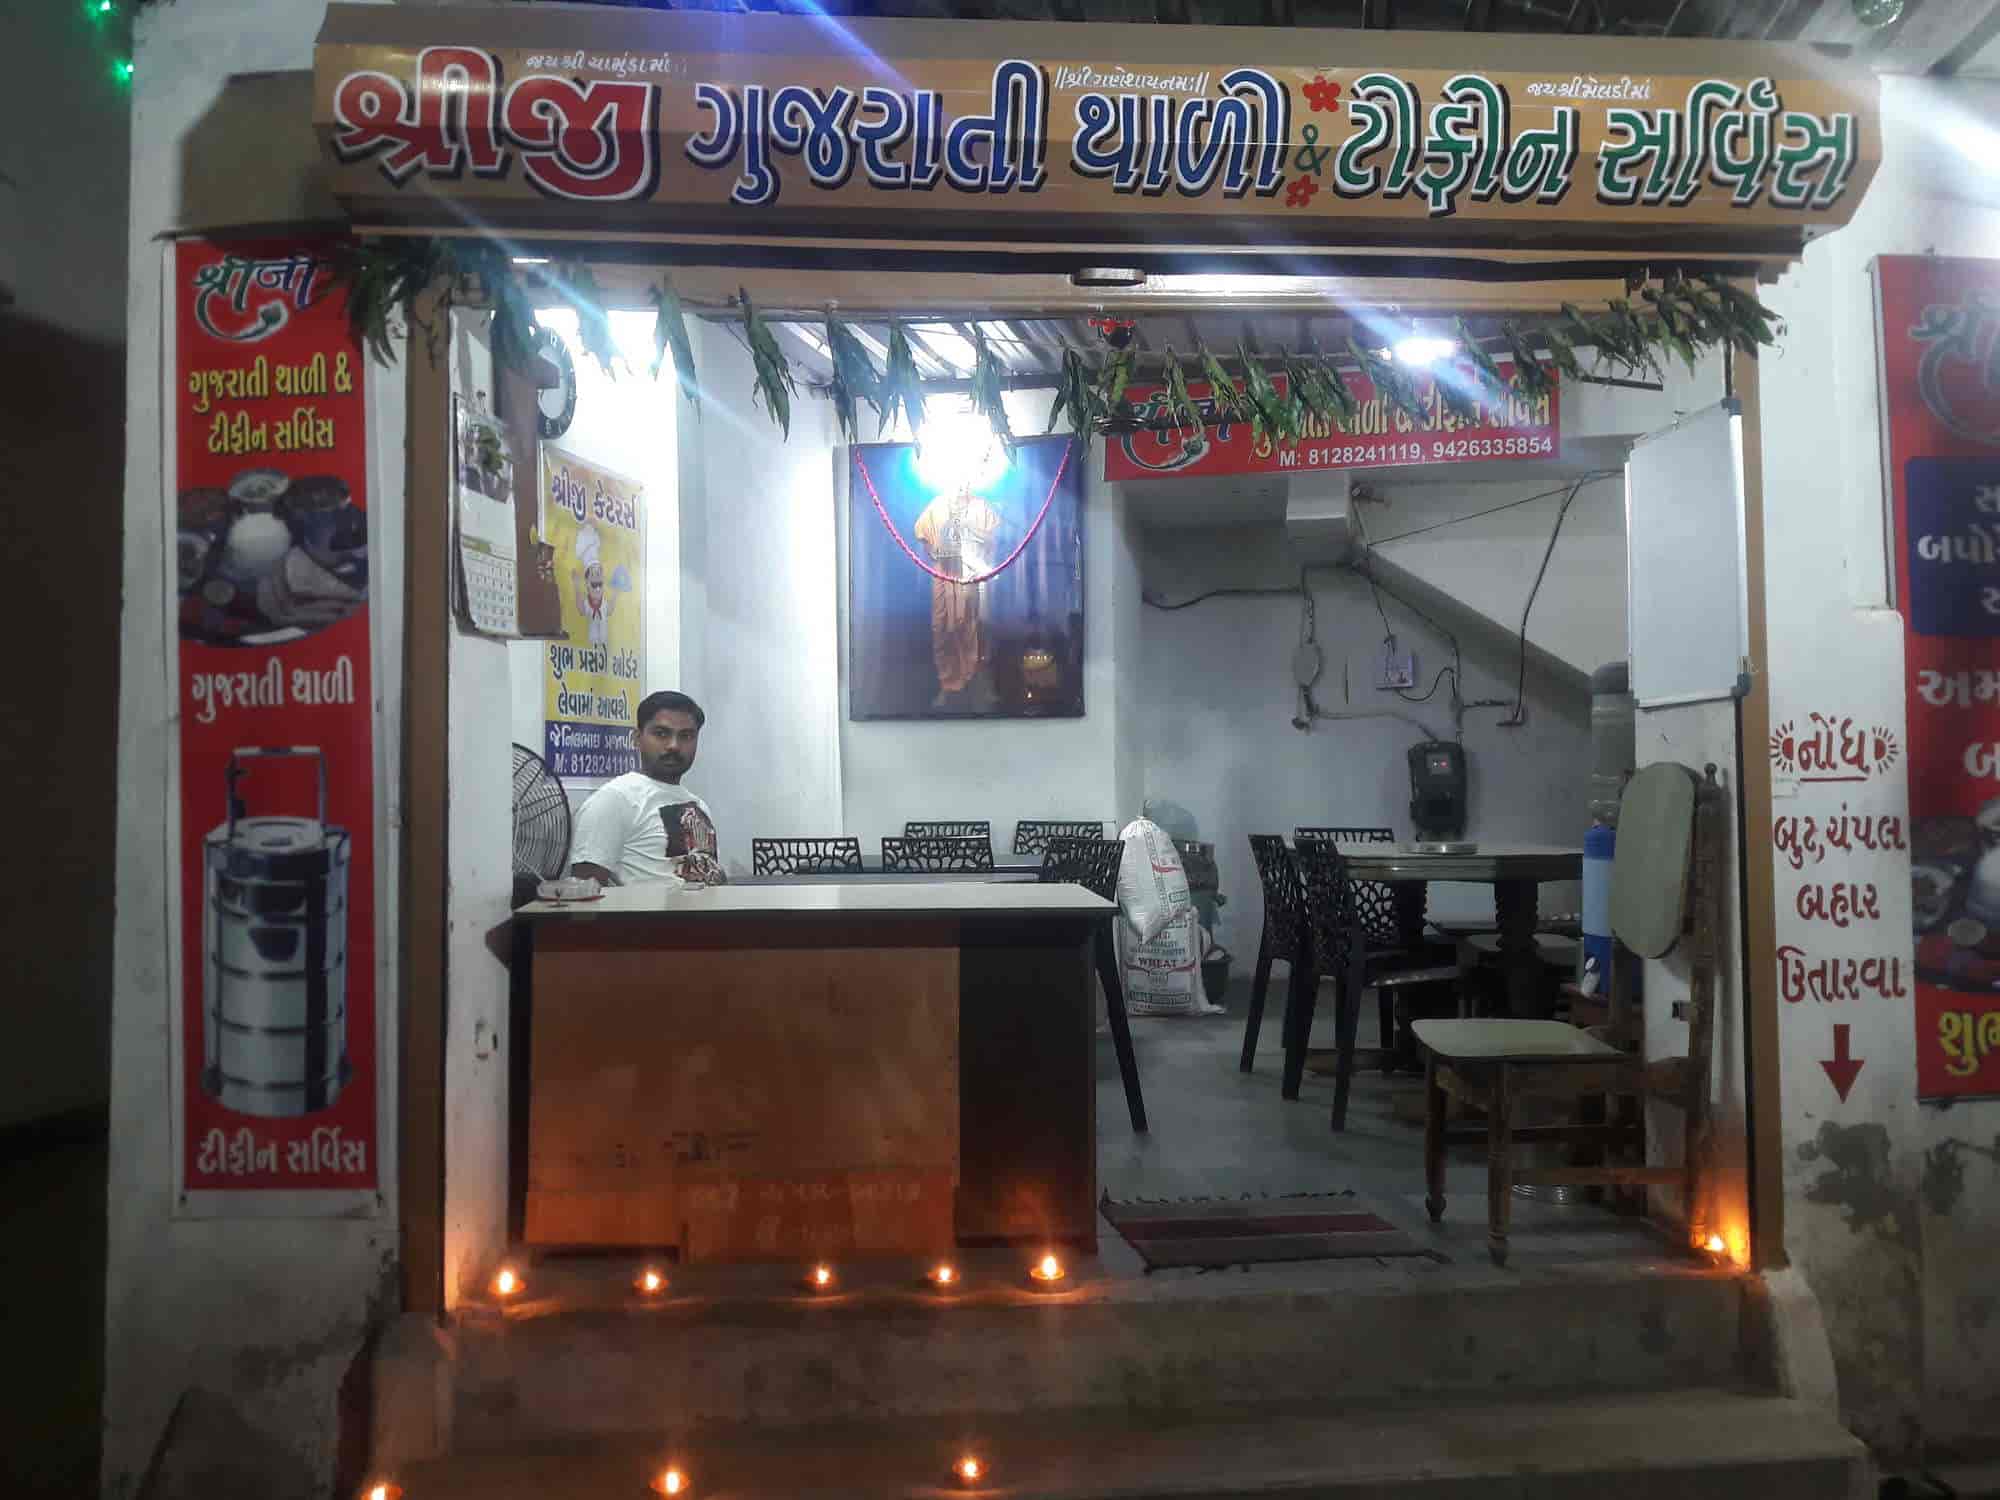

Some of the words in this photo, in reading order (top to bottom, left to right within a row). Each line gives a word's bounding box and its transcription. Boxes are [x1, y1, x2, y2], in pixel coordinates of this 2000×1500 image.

[332, 46, 658, 202] શ્રીજી
[684, 60, 1046, 205] ગુજરાતી
[1070, 68, 1288, 198] થાળી
[1294, 123, 1330, 177] &
[1334, 72, 1578, 217] ટીફીન
[189, 355, 268, 413] ગુજરાતી
[275, 352, 327, 394] થાળી
[334, 351, 352, 392] &
[208, 411, 267, 454] ટીફીન
[273, 407, 334, 449] સર્વિસ
[1279, 450, 1301, 467] M:
[1432, 437, 1553, 458] 9426335854
[191, 656, 284, 724] ગુજરાતી
[291, 655, 353, 705] થાળી
[1798, 711, 1870, 773] નોંધ
[1796, 882, 1880, 928] બહાર
[1777, 945, 1906, 1003] ઉતારવા
[198, 1127, 278, 1175] ટીફીન
[287, 1124, 367, 1174] સર્વિસ
